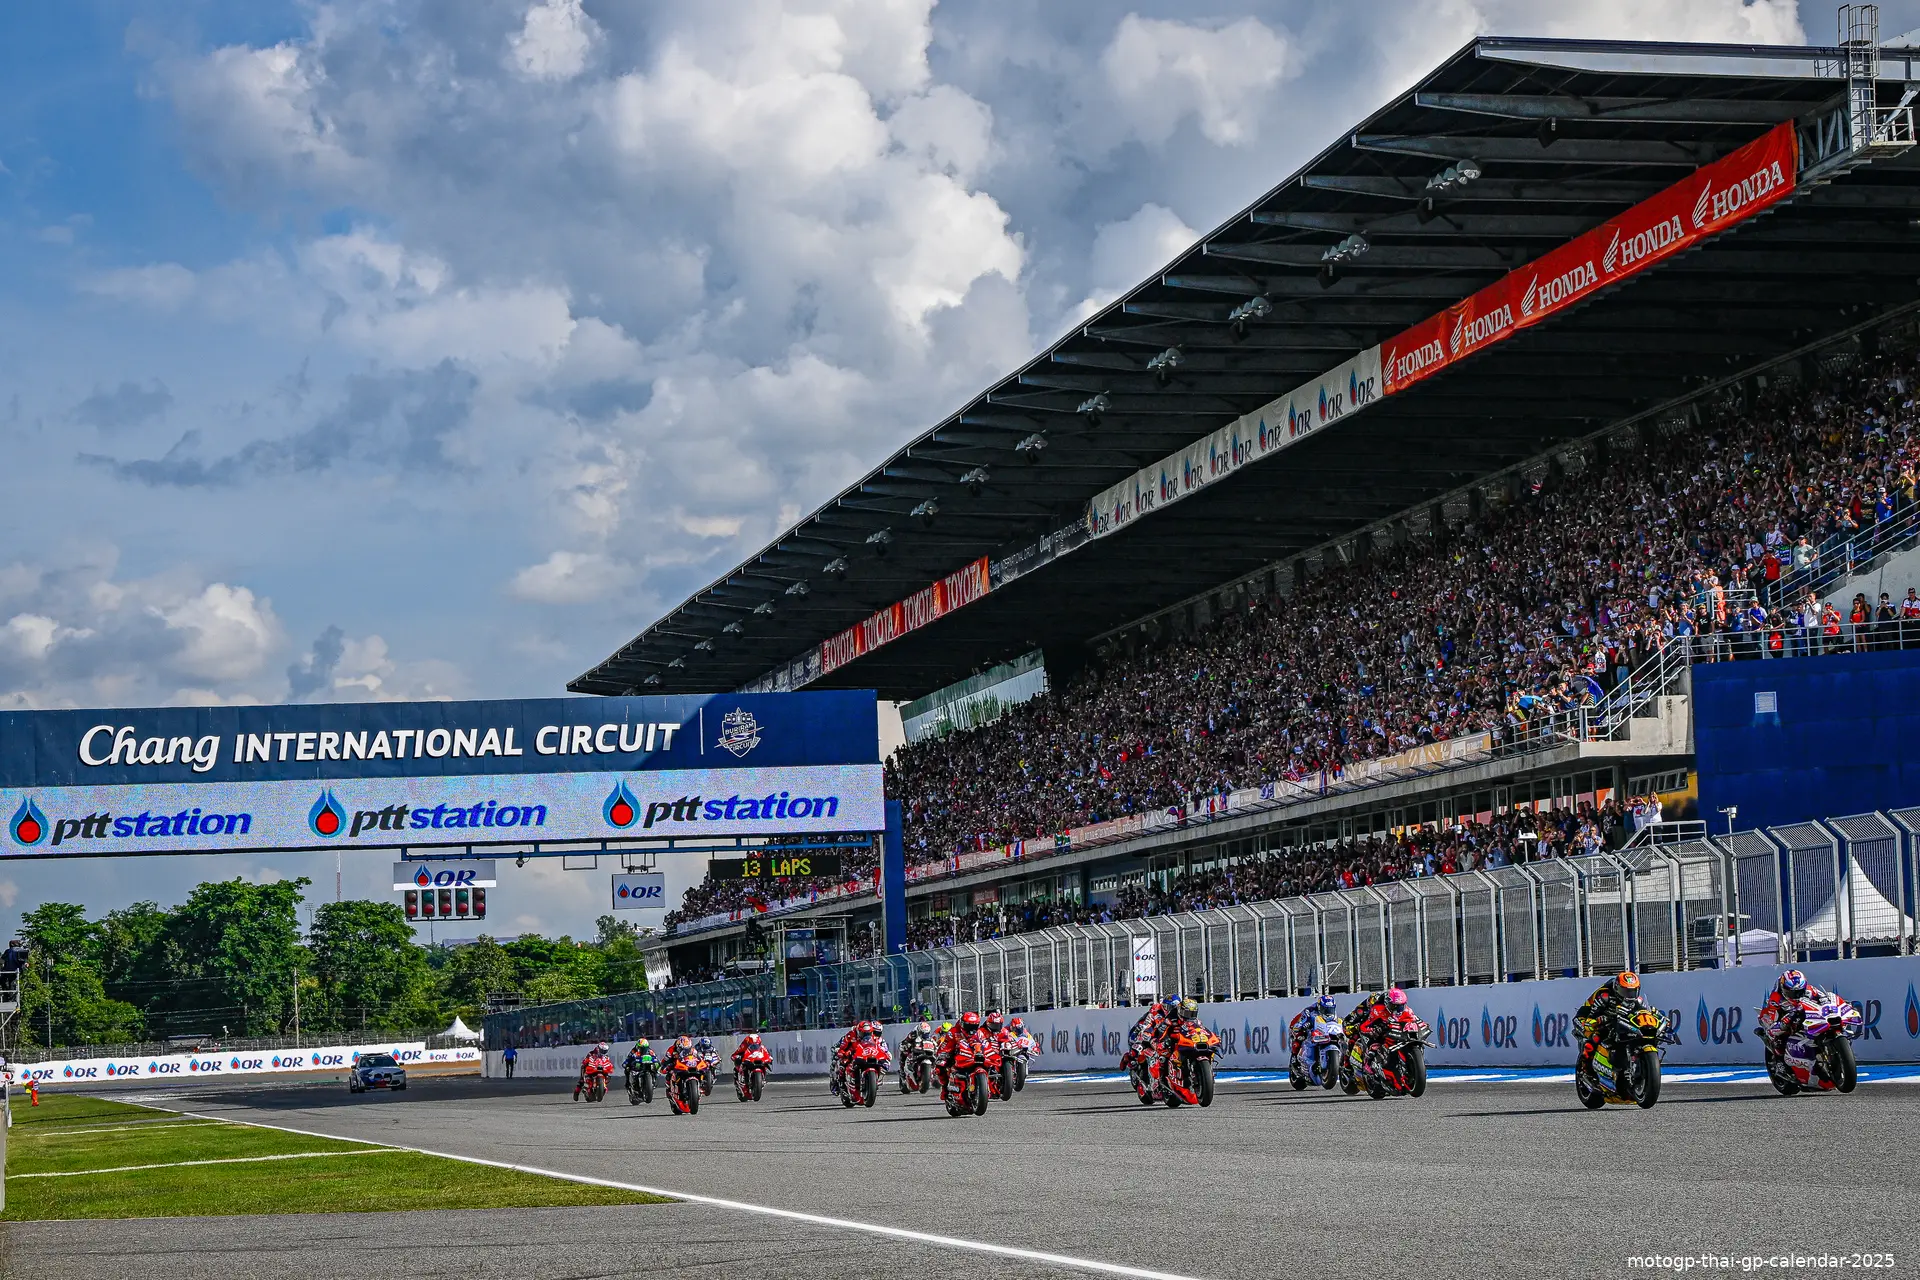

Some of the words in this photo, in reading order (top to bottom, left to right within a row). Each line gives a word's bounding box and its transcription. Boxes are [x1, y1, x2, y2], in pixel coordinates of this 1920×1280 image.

[1397, 339, 1444, 381] HONDA
[1463, 304, 1514, 347] HONDA
[1538, 260, 1598, 310] HONDA
[1620, 214, 1685, 267] HONDA
[1712, 160, 1785, 221] HONDA
[826, 629, 855, 670] TOYOTA
[863, 609, 895, 651] TOYOTA
[903, 586, 934, 633] TOYOTA
[945, 562, 983, 611] TOYOTA
[79, 725, 221, 773] Chang
[234, 727, 523, 764] INTERNATIONAL
[535, 722, 681, 756] CIRCUIT
[433, 869, 477, 887] OR
[742, 860, 761, 877] 13
[771, 858, 811, 876] LAPS
[631, 885, 662, 898] OR
[1056, 1030, 1069, 1053] OR
[1081, 1032, 1095, 1056] OR
[1108, 1031, 1122, 1055] OR
[1220, 1028, 1237, 1054] OR
[1252, 1026, 1270, 1054] OR
[1448, 1017, 1471, 1049] OR
[1493, 1015, 1517, 1048] OR
[1543, 1013, 1570, 1048] OR
[1711, 1005, 1743, 1045] OR
[1636, 1013, 1657, 1027] 10
[32, 1069, 53, 1079] OR
[75, 1067, 97, 1078] OR
[117, 1064, 139, 1075] OR
[159, 1062, 180, 1073] OR
[200, 1060, 222, 1071] OR
[241, 1059, 263, 1069] OR
[282, 1056, 303, 1067] OR
[322, 1055, 343, 1065] OR
[402, 1050, 422, 1060] OR
